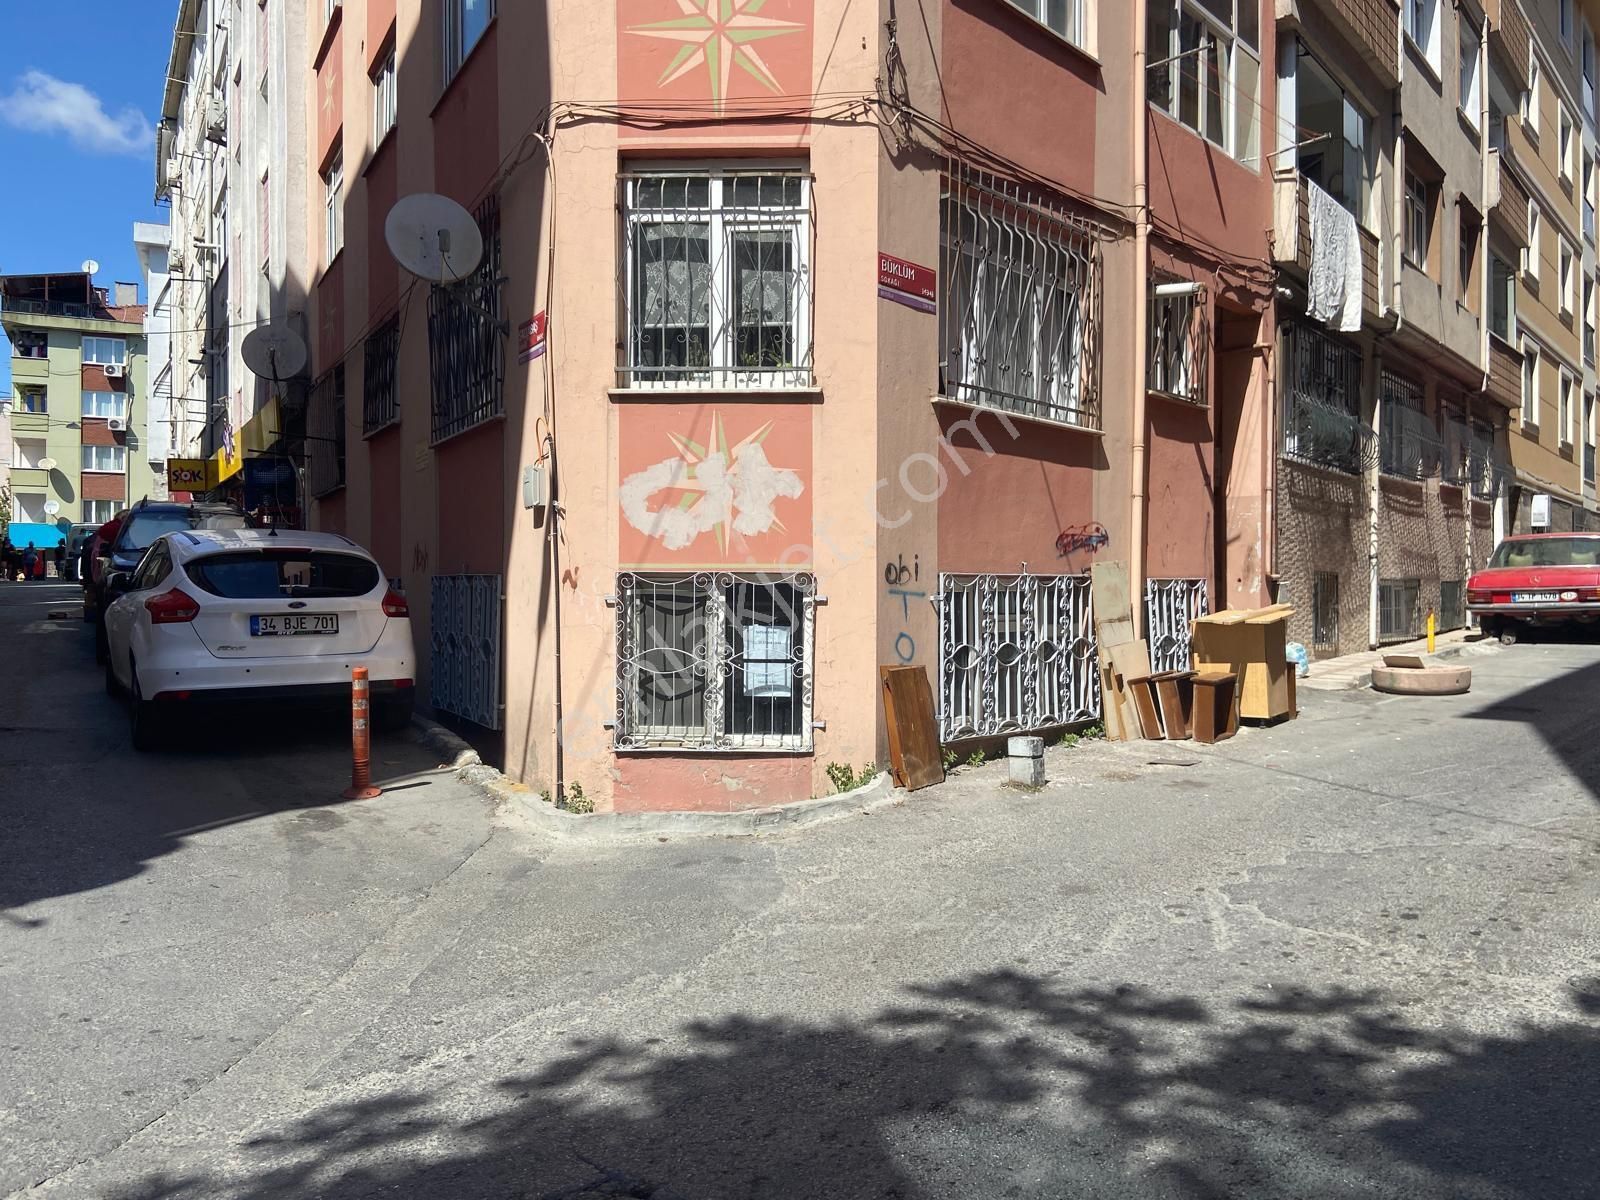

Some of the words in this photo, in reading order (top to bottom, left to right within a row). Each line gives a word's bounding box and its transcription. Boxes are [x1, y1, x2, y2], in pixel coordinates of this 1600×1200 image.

[881, 258, 915, 280] BÜKLÜM
[172, 469, 203, 484] ŞOK
[261, 618, 276, 630] 34
[284, 617, 307, 630] BJE
[313, 616, 334, 629] 701
